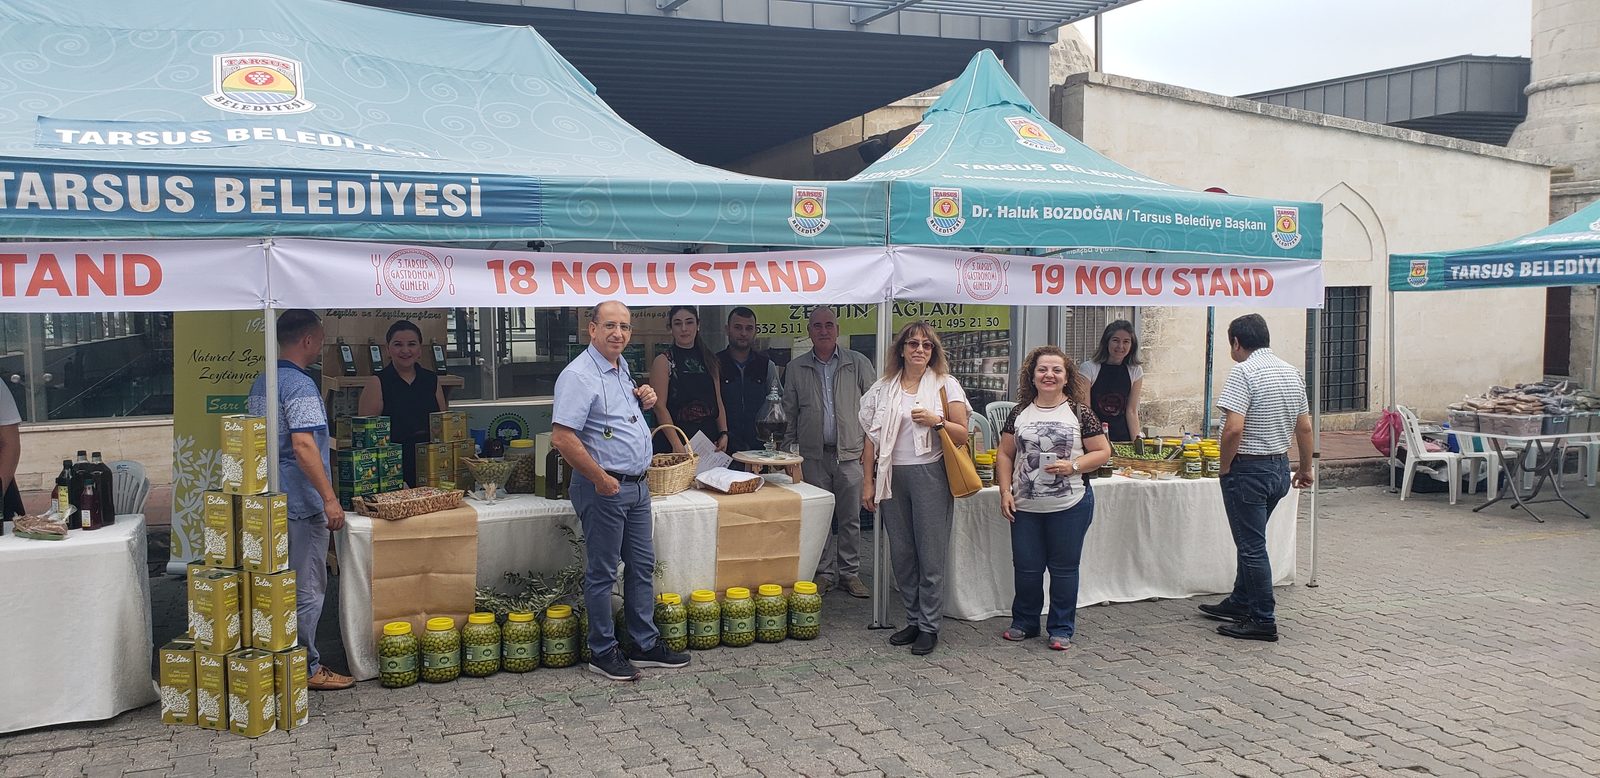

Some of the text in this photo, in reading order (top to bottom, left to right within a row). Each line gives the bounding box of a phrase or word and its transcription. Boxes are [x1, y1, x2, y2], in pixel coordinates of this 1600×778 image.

[224, 59, 291, 70] TARSUS
[55, 129, 212, 145] TARSUS
[953, 163, 1047, 171] TARSUS
[0, 168, 482, 217] TARSUS BELEDİYESİ
[972, 205, 1266, 232] Dr. Haluk BOZDOĞAN / Tarsus Belediye Başkanı
[1451, 255, 1600, 280] TARSUS BELEDİY
[487, 260, 827, 295] 18 NOLU STAND
[1032, 264, 1274, 297] 19 NOLU STAND
[892, 302, 963, 318] AĞLARI
[756, 323, 802, 334] 532 511
[946, 318, 966, 328] 495
[970, 318, 981, 328] 21
[986, 317, 999, 327] 30
[188, 349, 235, 364] Naturel
[199, 366, 259, 384] Zeytinya
